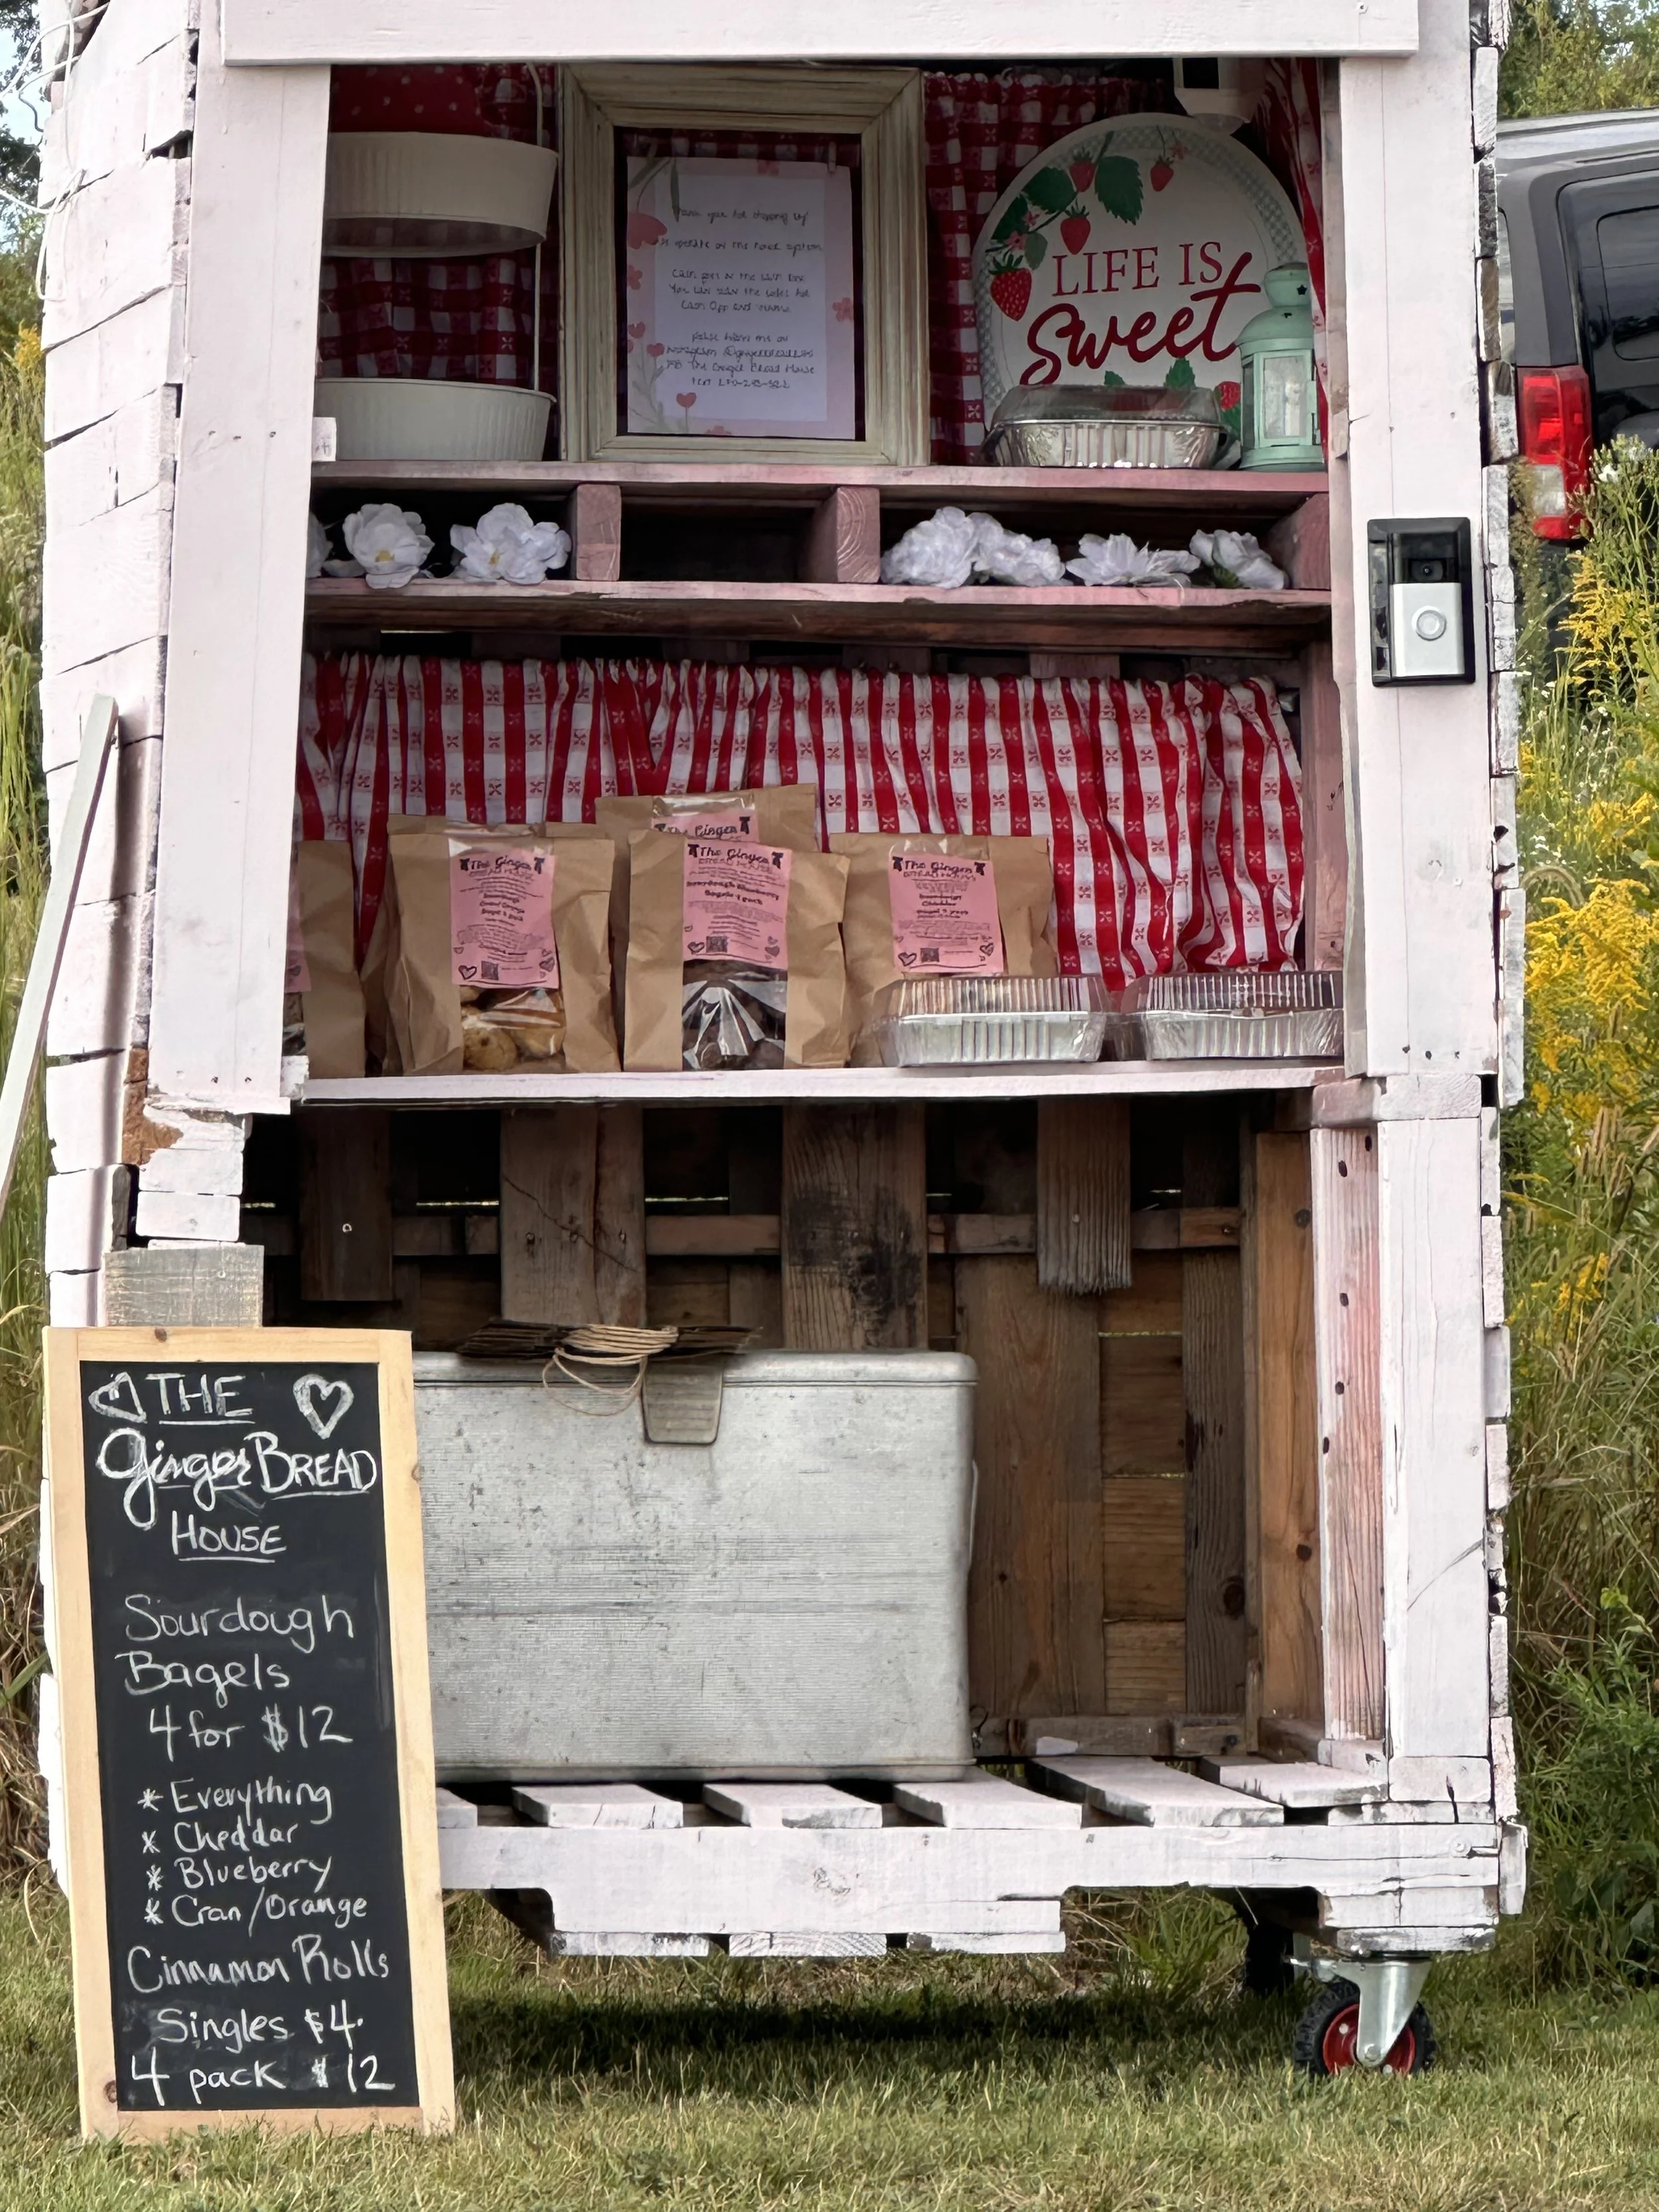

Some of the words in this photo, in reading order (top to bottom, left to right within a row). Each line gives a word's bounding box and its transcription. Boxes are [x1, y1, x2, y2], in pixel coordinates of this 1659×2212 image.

[1052, 246, 1160, 297] LIFE
[1179, 241, 1223, 286] IS
[145, 1371, 253, 1418] THE
[171, 1510, 287, 1556] HOUSE
[125, 1593, 354, 1654] Sourdough
[115, 1650, 291, 1709] Bagels
[149, 1704, 182, 1763] 4
[188, 1709, 246, 1748] for
[170, 1776, 332, 1826] Everything
[173, 1814, 299, 1854] Cheddar
[174, 1856, 332, 1893] Blueberry
[127, 1945, 290, 1994] Cinnamon
[292, 1933, 390, 1986] Rolls
[157, 2007, 291, 2055] Singles
[131, 2045, 171, 2107] 4
[188, 2059, 287, 2105] pack
